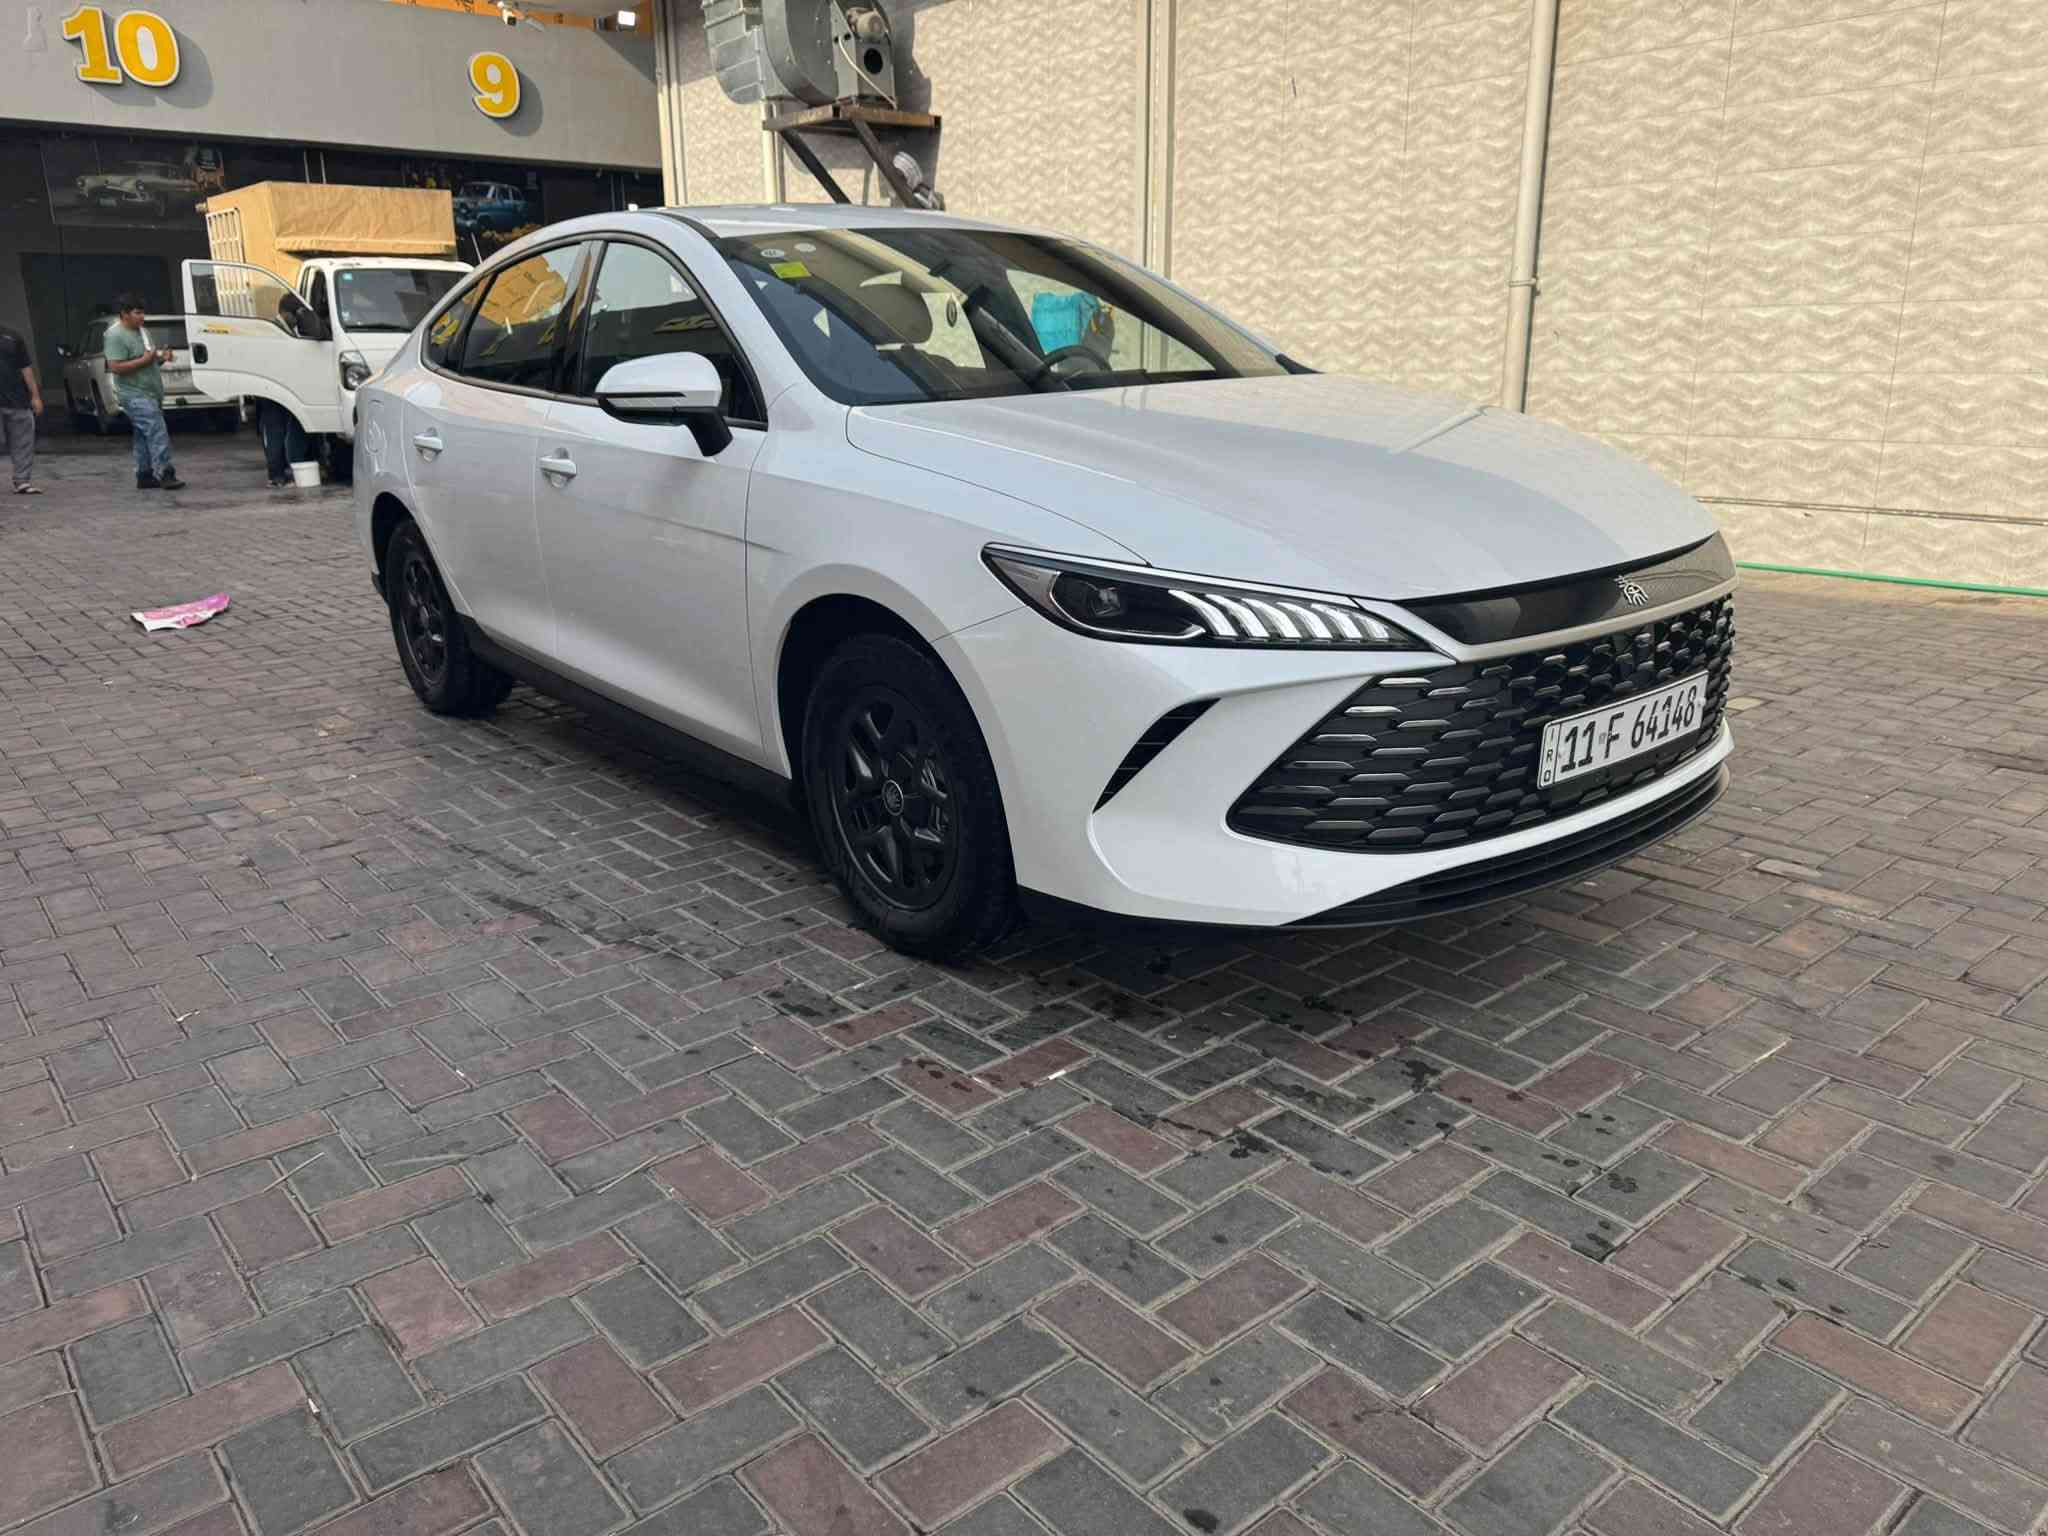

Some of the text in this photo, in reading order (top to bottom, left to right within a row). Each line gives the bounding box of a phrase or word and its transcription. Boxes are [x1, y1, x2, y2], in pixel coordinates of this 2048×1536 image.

[63, 6, 180, 87] 10
[469, 52, 521, 118] 9
[1561, 685, 1697, 772] 11 F 64148
